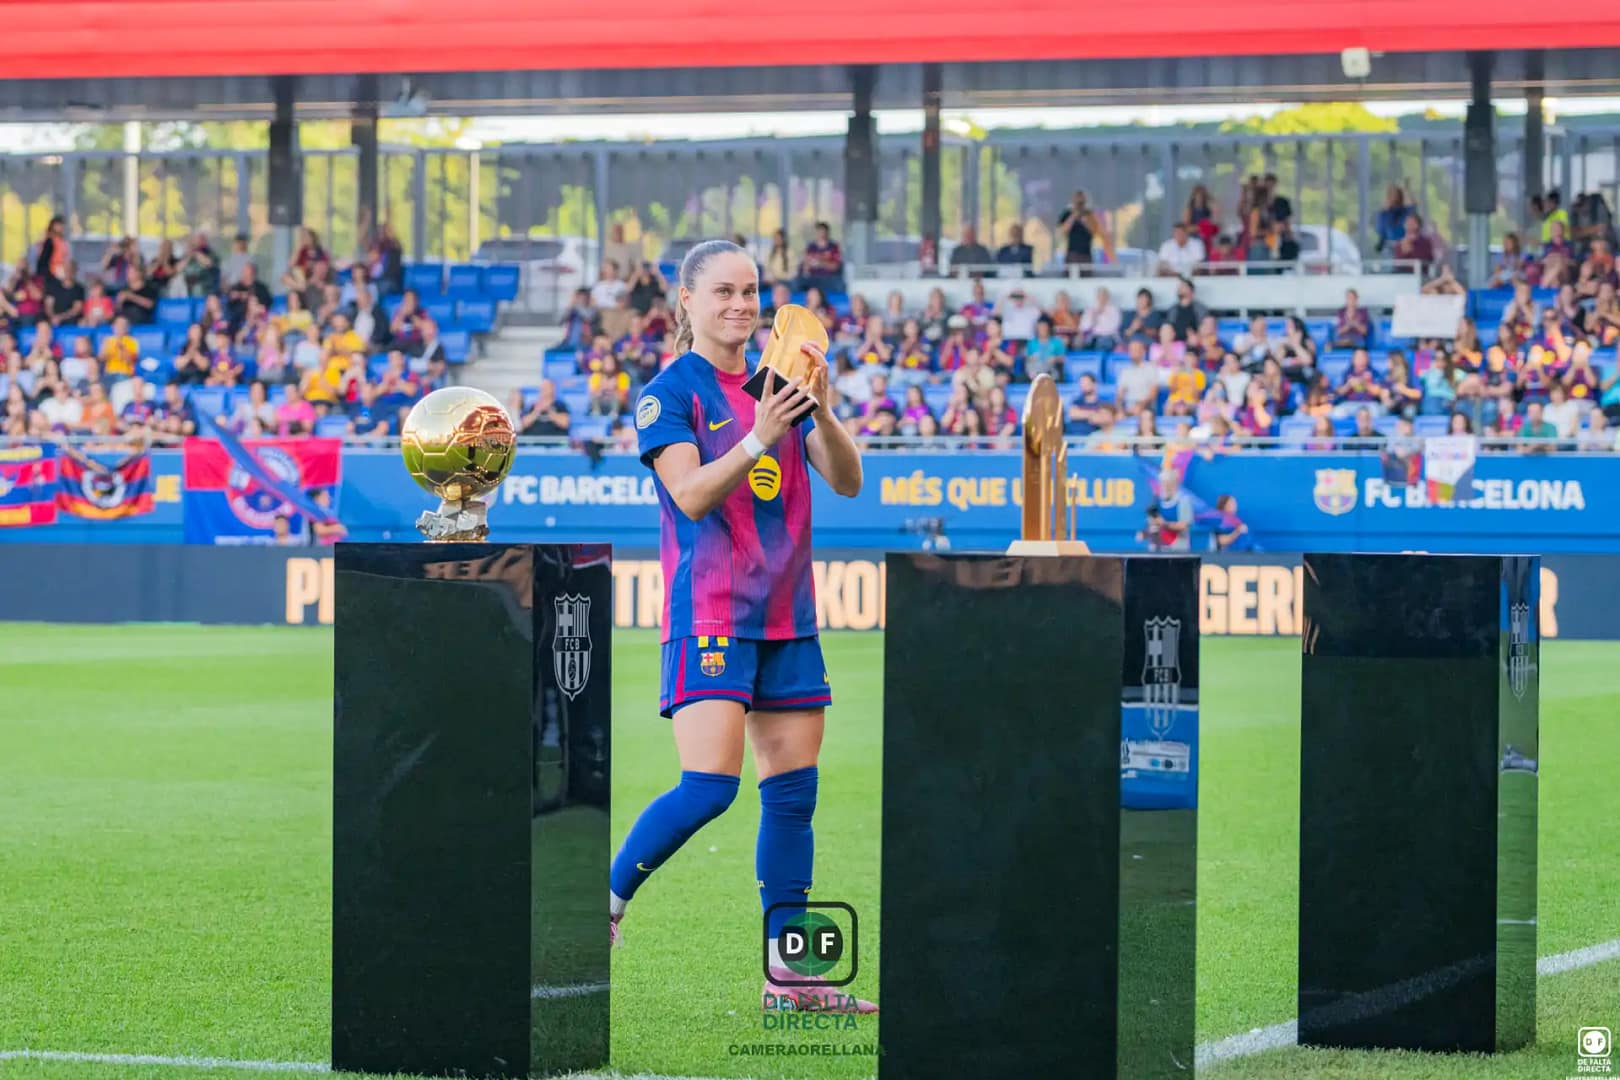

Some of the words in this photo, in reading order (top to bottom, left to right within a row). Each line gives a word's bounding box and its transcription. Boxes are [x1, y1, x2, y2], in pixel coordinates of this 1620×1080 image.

[503, 476, 538, 505] FC
[881, 469, 942, 505] MÉS
[947, 477, 1007, 511] QUE
[1405, 480, 1585, 510] BCELONA
[564, 638, 580, 650] FCB
